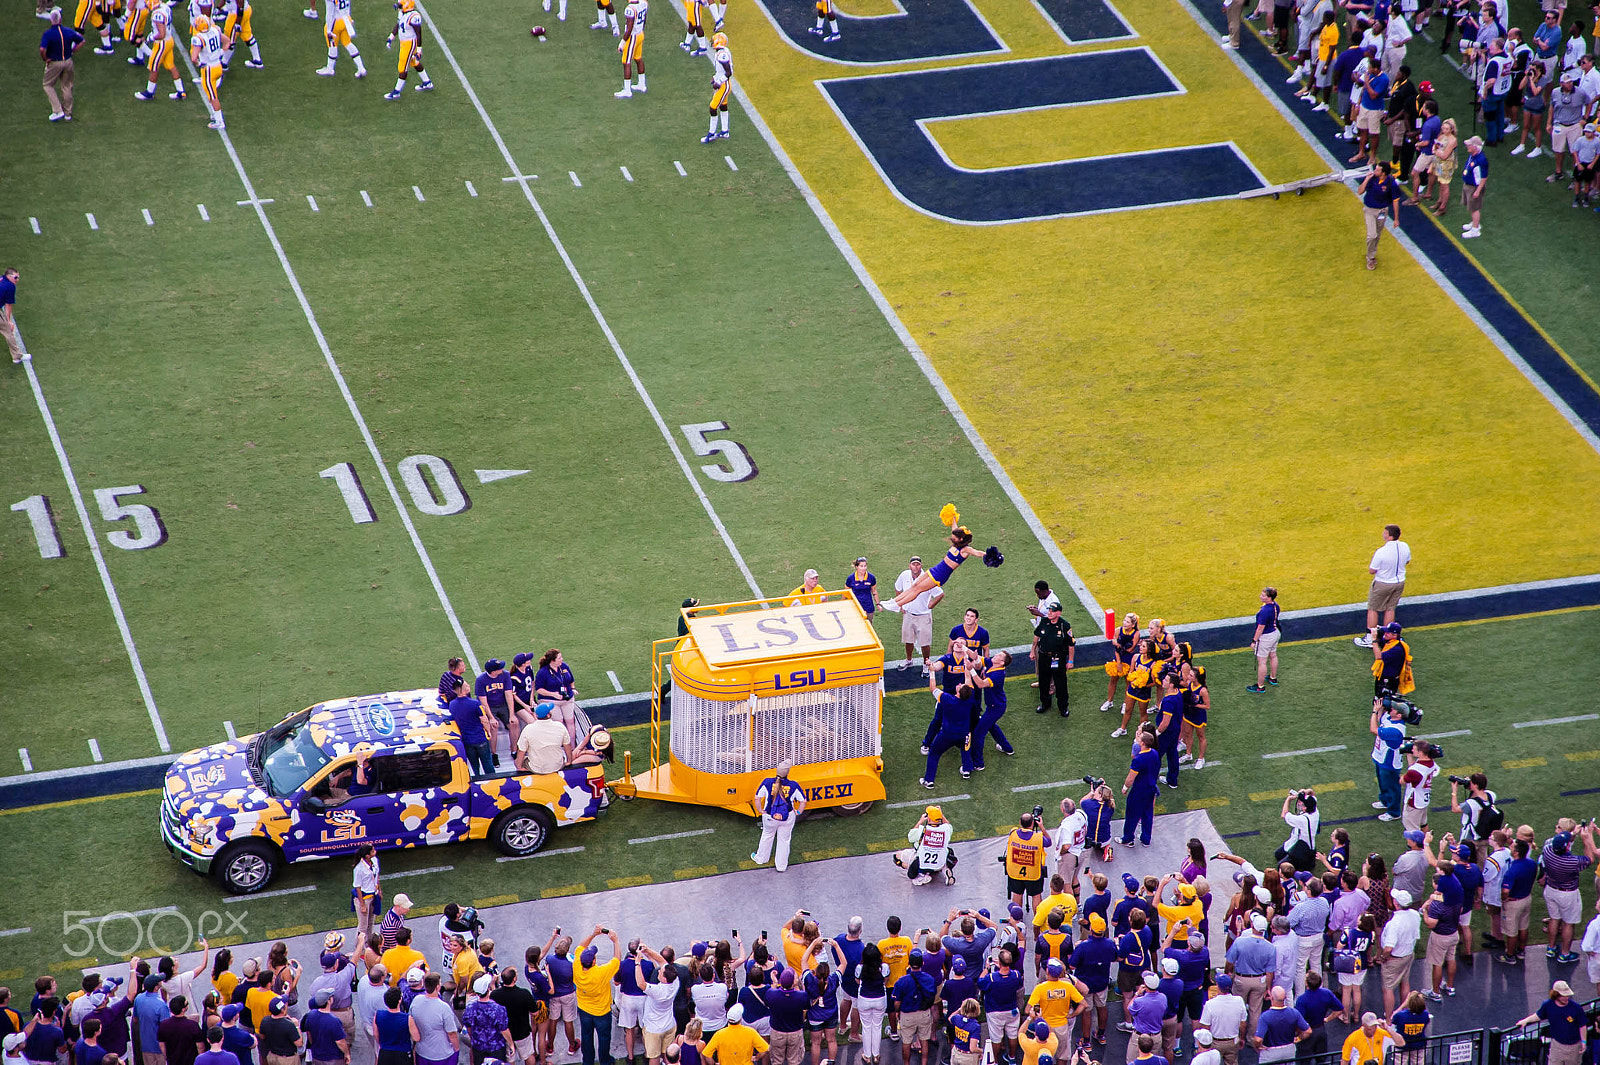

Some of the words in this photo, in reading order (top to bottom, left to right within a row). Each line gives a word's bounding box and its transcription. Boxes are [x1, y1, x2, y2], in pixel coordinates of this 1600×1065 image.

[208, 36, 219, 52] 81
[680, 420, 758, 483] 5
[318, 454, 472, 524] 10
[11, 484, 167, 559] 15
[710, 610, 846, 653] LSU
[485, 682, 504, 693] LSU
[524, 675, 533, 693] 8
[773, 668, 826, 691] LSU
[186, 766, 214, 794] LSU
[835, 783, 854, 798] VI
[320, 825, 367, 843] LSU
[923, 852, 939, 864] 22
[1019, 866, 1027, 877] 4
